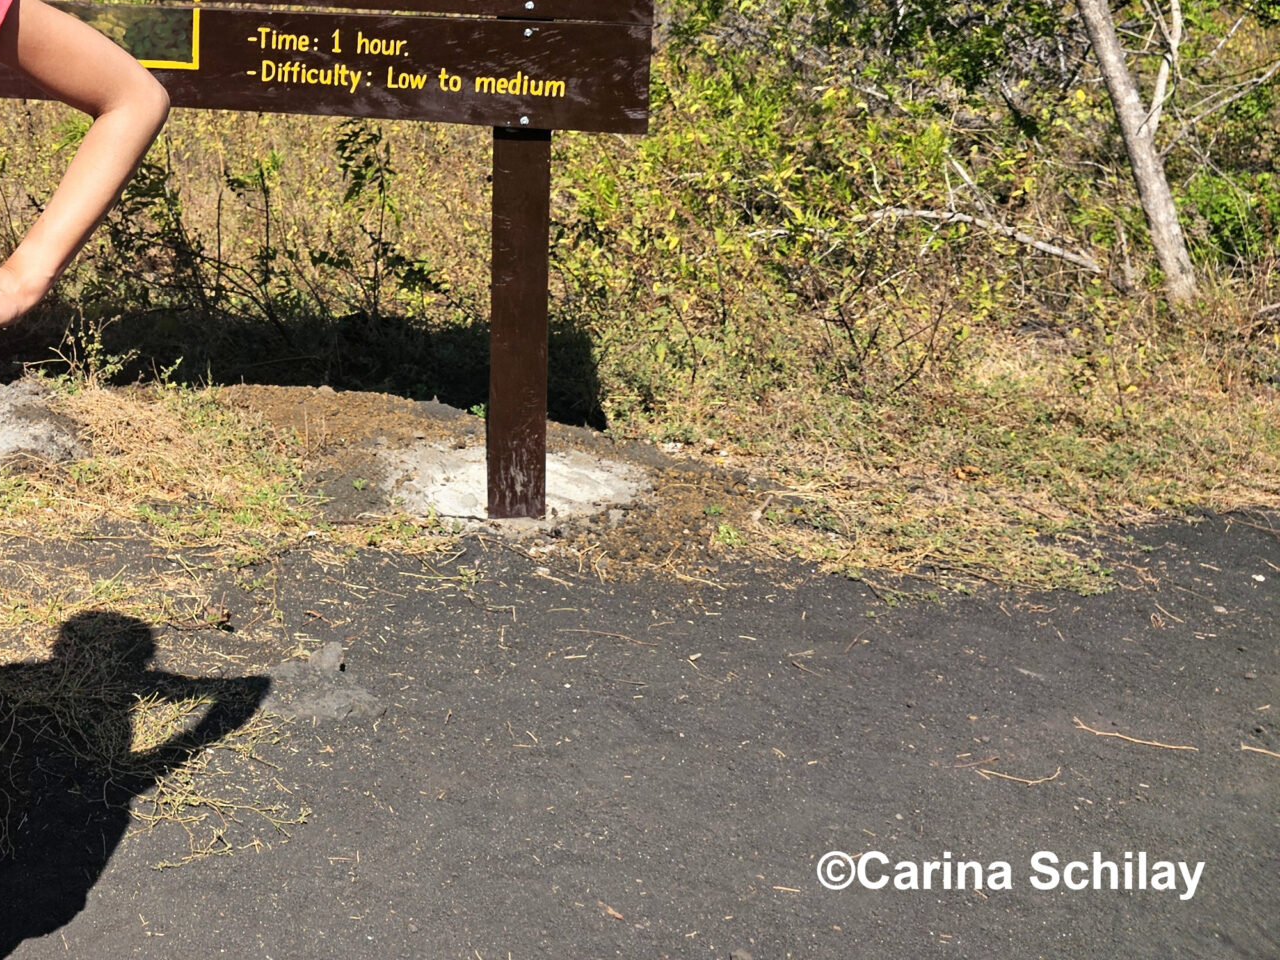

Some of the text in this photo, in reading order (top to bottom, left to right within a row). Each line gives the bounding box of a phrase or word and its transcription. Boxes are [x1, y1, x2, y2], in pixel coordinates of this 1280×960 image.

[331, 28, 342, 54] 1
[357, 32, 410, 57] hour.
[386, 66, 427, 90] Low
[438, 67, 462, 92] to
[475, 71, 566, 97] medium
